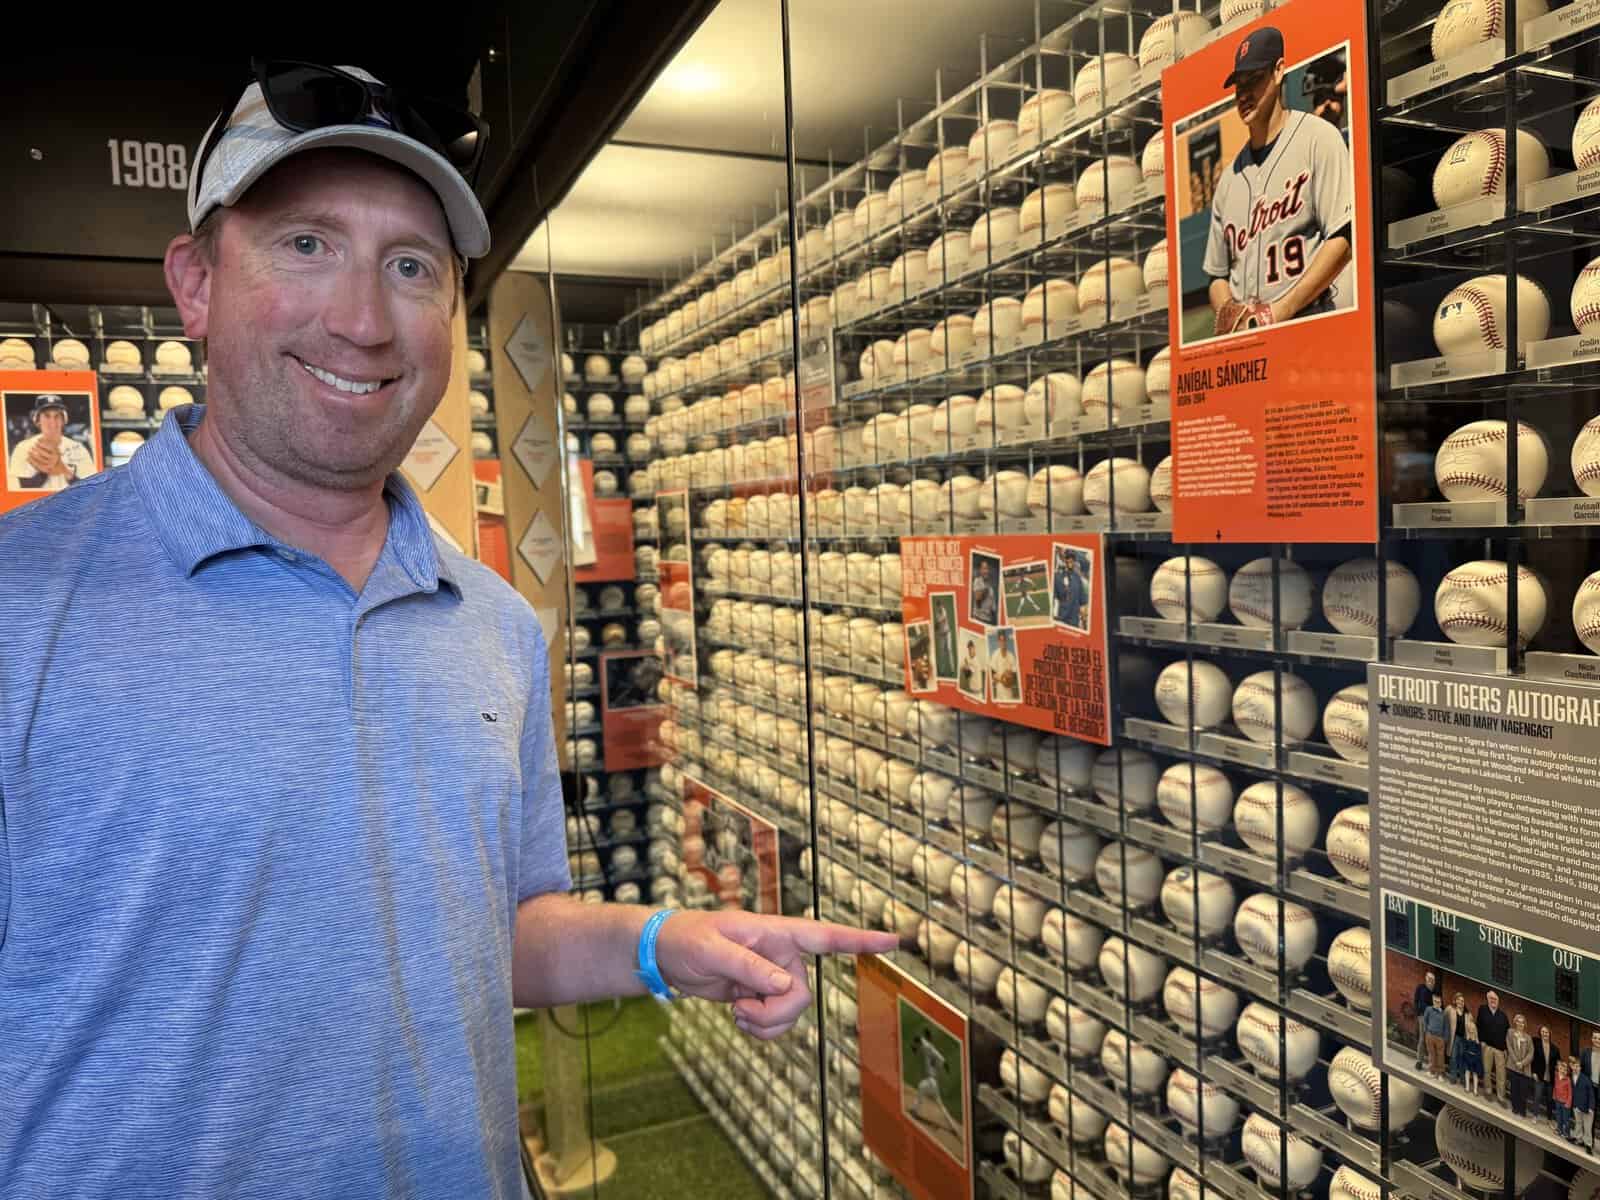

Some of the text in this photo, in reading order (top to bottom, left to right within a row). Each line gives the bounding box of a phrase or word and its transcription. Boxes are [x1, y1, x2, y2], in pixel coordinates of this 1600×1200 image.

[1558, 8, 1582, 21] Victor
[107, 137, 188, 190] 1988
[1224, 170, 1309, 252] Detroit
[1265, 236, 1306, 284] 19
[1177, 358, 1268, 394] ANÍBAL SÁNCHEZ
[1378, 673, 1441, 706] DETROIT
[1444, 681, 1502, 715] TIGERS
[1427, 709, 1453, 724] STEVE
[1453, 713, 1471, 728] AND
[1473, 716, 1499, 733] MARY
[1500, 720, 1555, 740] NAGENGAST
[1499, 743, 1519, 752] when
[1533, 748, 1555, 760] family
[1558, 753, 1596, 765] relocated
[1528, 768, 1543, 777] Mall
[1561, 774, 1581, 784] while
[1530, 759, 1573, 772] autographs
[1510, 793, 1549, 805] purchases
[1551, 799, 1582, 813] through
[1561, 814, 1578, 822] with
[1520, 835, 1558, 850] Highlights
[1560, 844, 1588, 857] include
[1555, 832, 1582, 844] largest
[1387, 894, 1583, 973] BAT BALL STRIKE OUT
